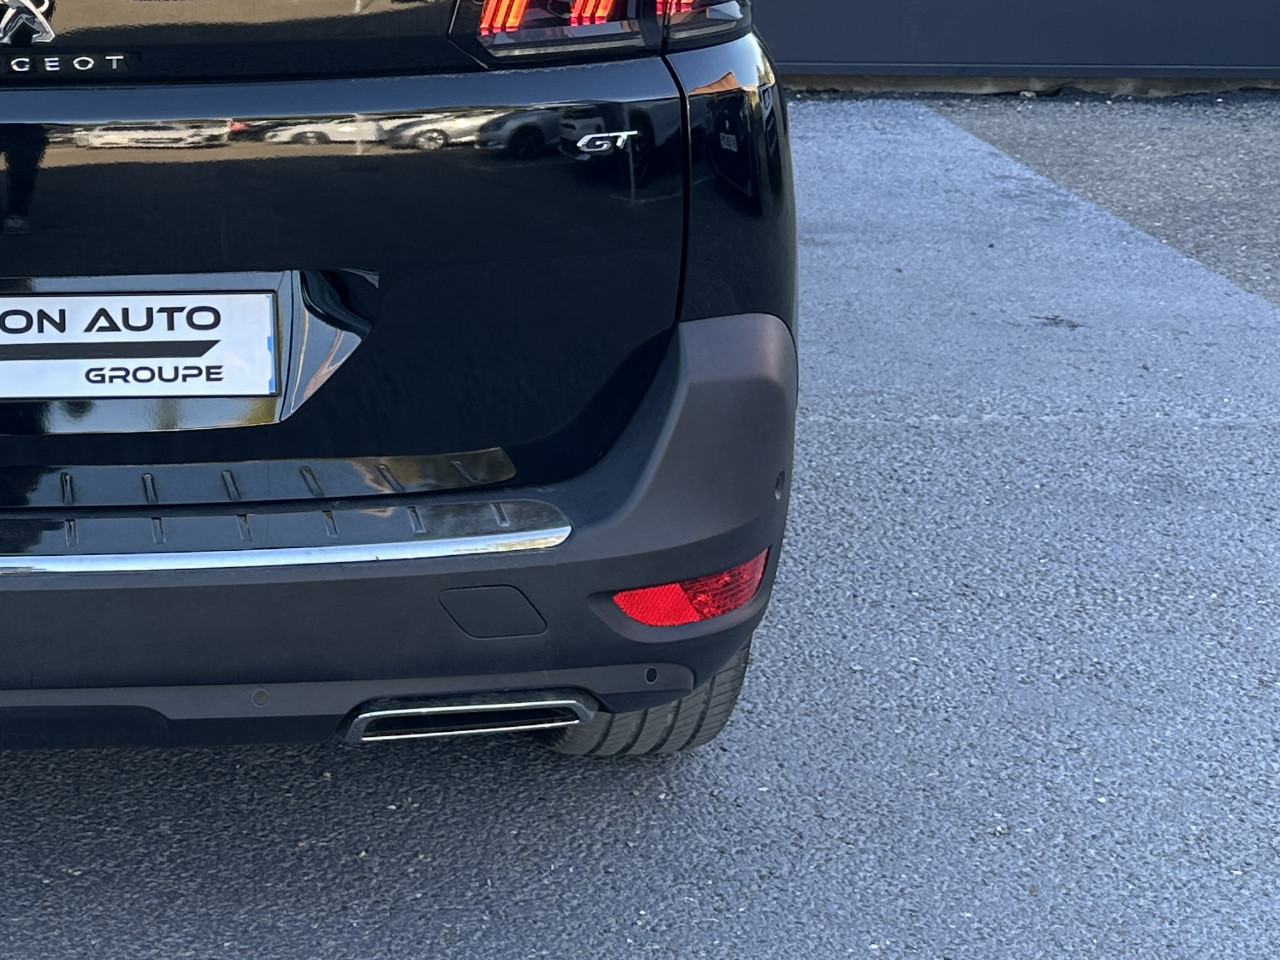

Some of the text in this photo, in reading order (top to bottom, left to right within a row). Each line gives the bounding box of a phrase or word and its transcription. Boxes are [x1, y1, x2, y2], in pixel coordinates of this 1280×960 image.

[576, 130, 638, 152] GT
[83, 306, 222, 334] AUTO
[84, 365, 224, 384] GROUPE
